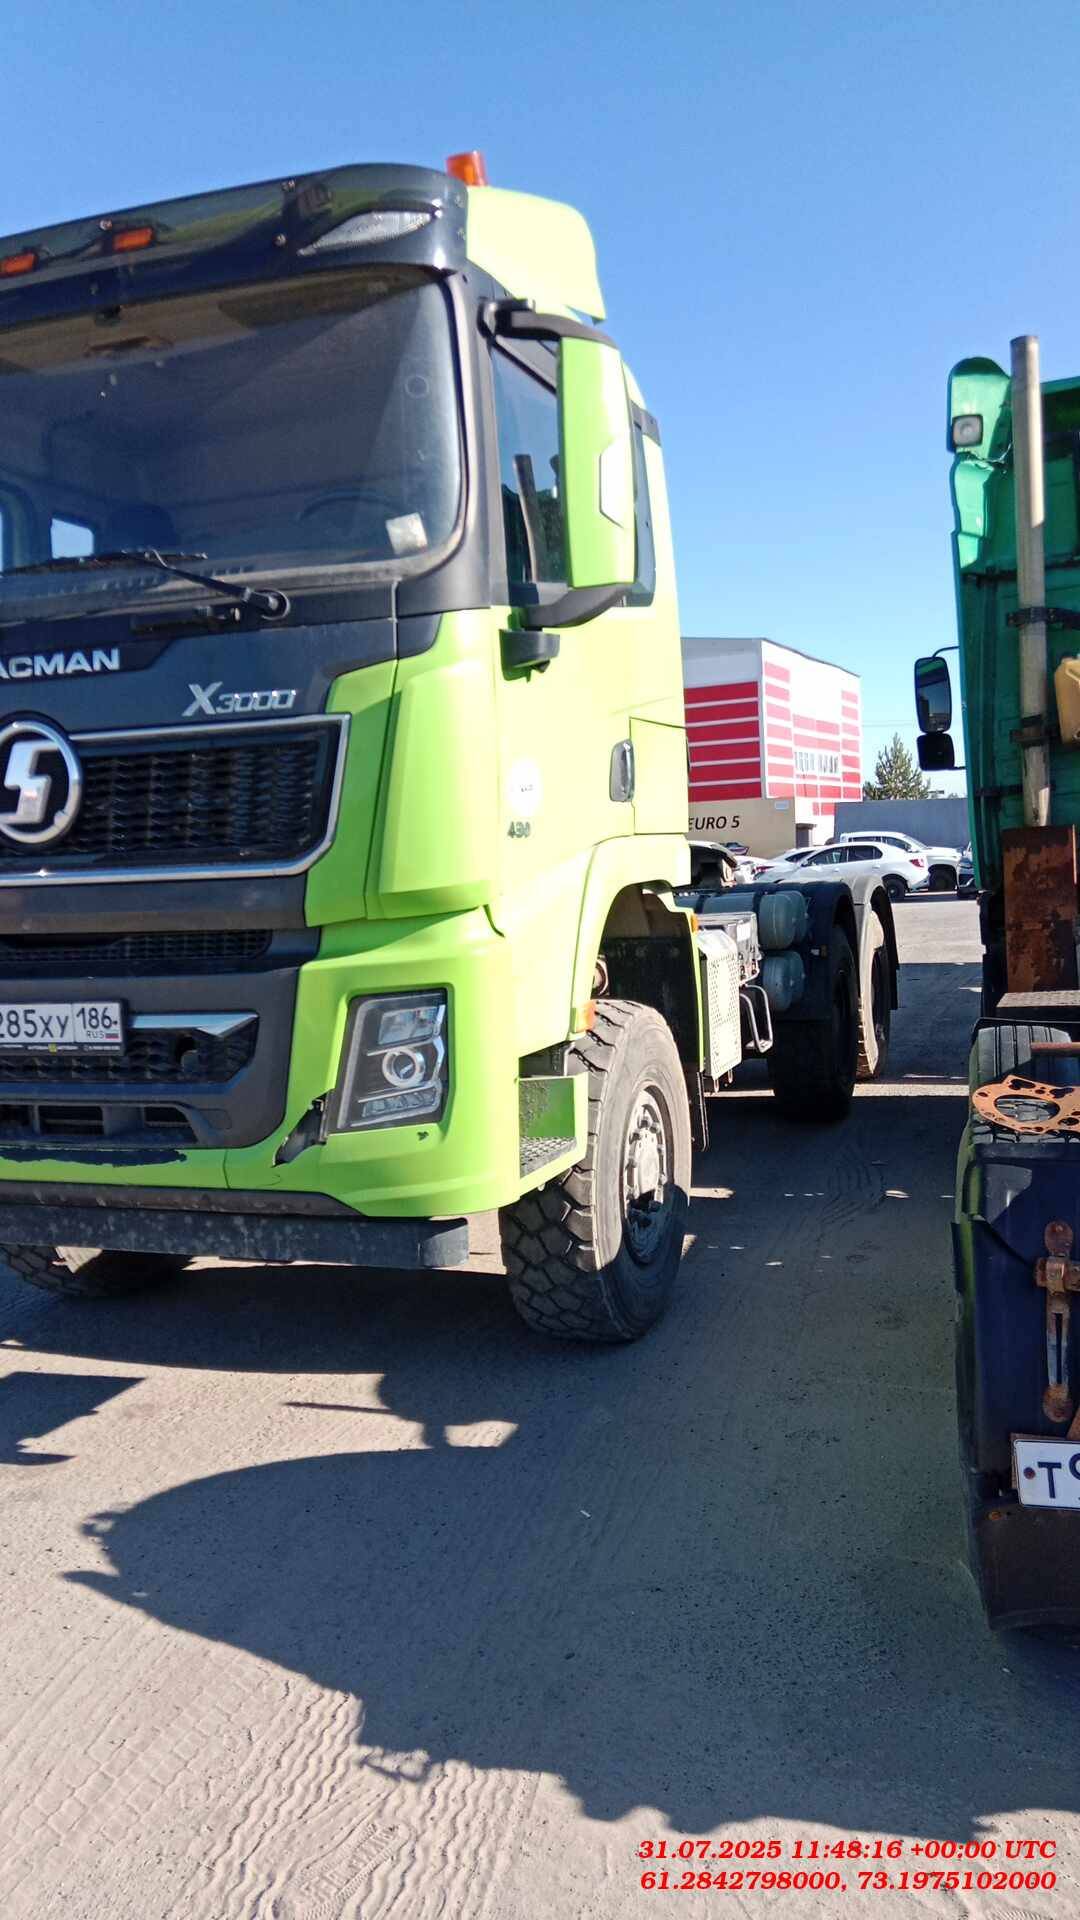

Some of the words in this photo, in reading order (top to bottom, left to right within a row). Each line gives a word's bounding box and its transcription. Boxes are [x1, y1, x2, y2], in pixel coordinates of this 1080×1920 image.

[181, 681, 297, 716] X3000
[507, 821, 530, 839] 430
[731, 815, 741, 828] 5
[76, 1007, 112, 1029] 186
[87, 1030, 104, 1039] RUS
